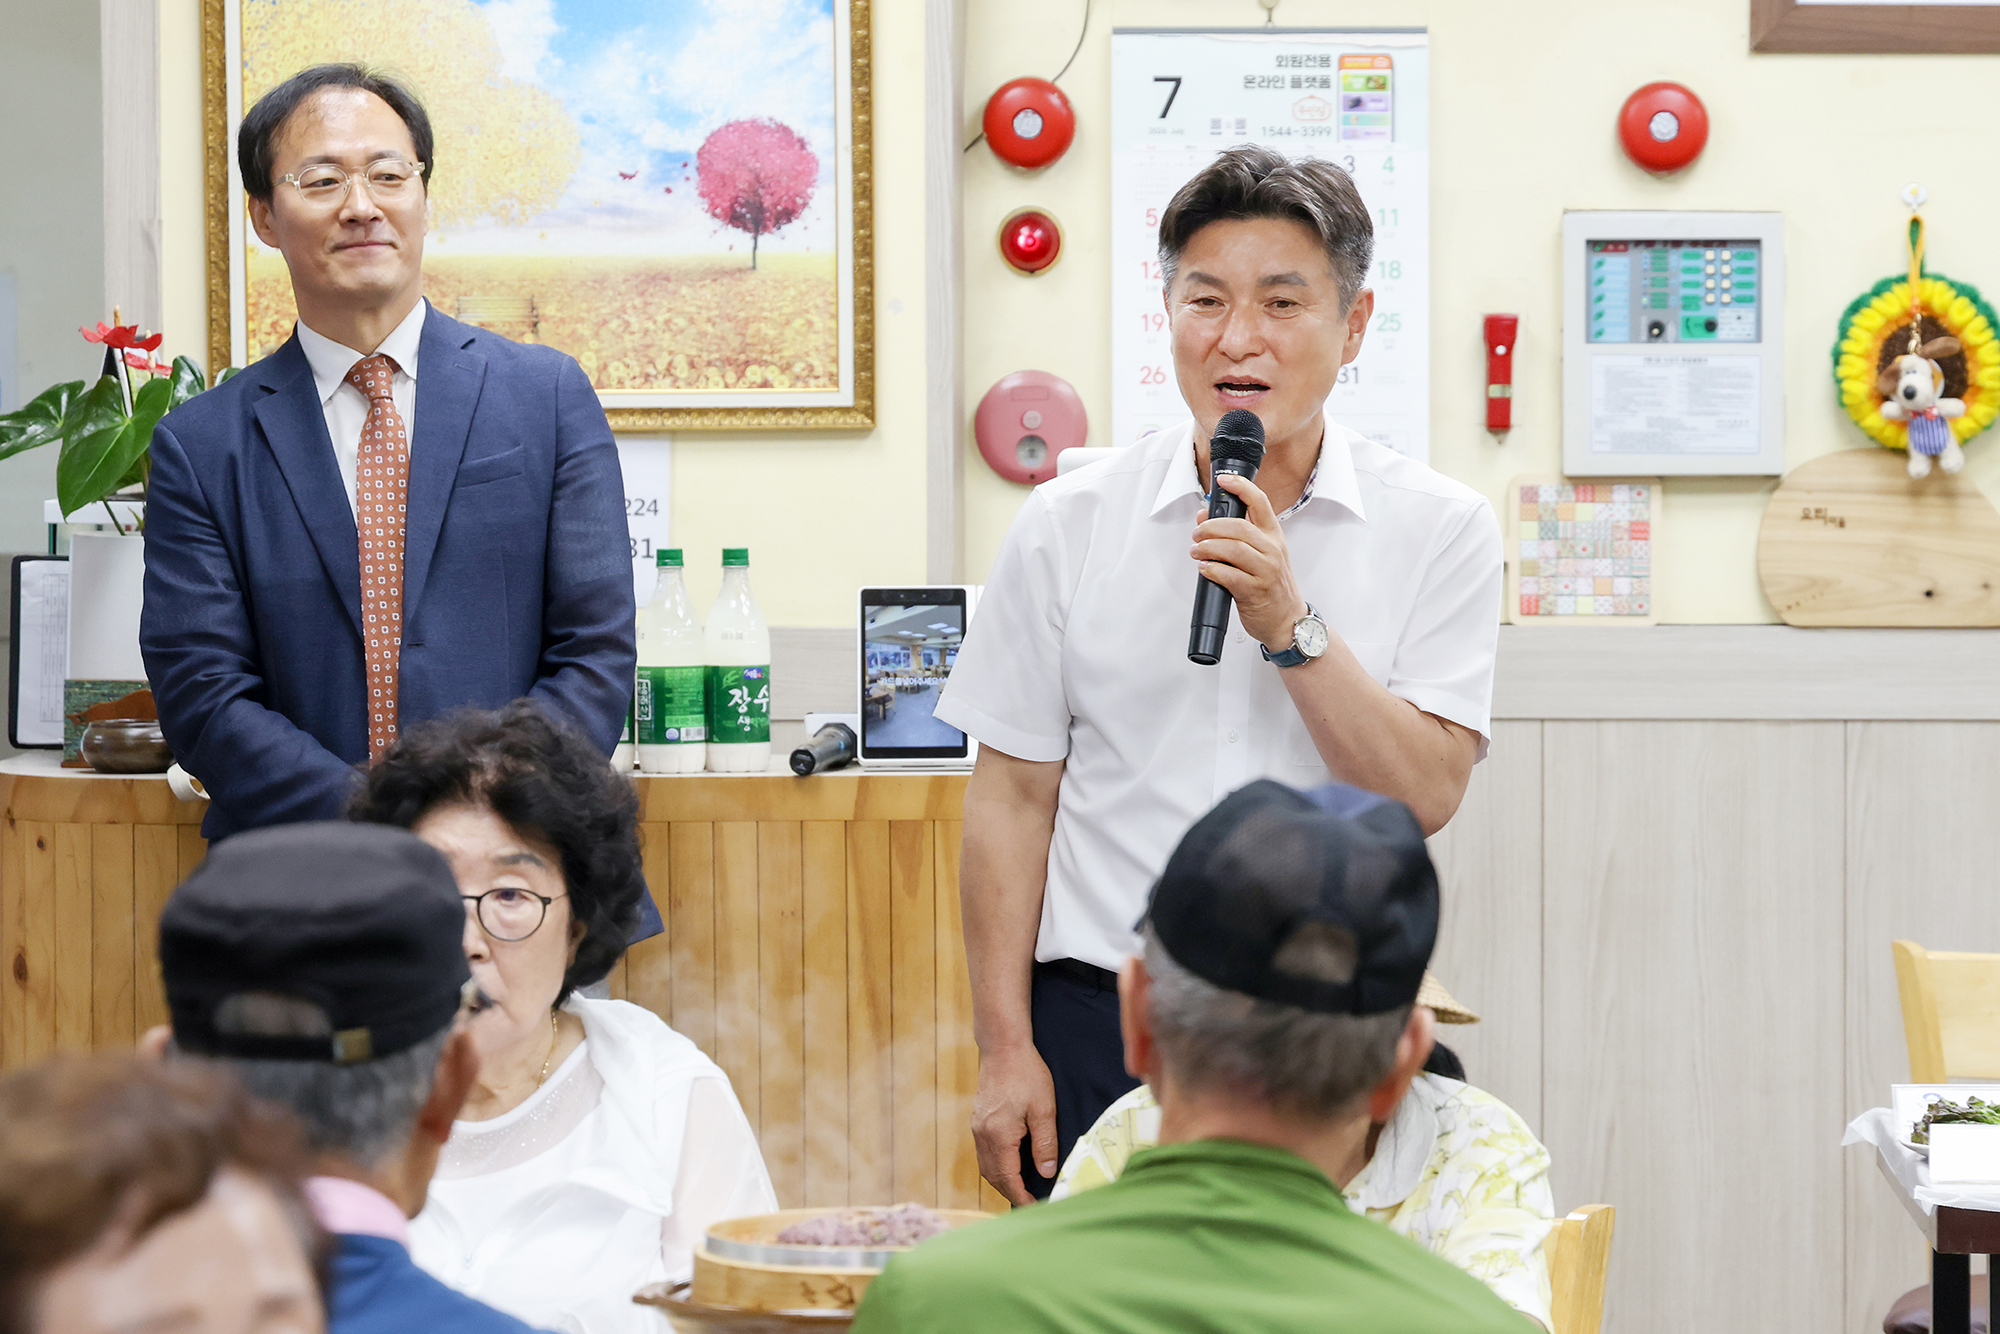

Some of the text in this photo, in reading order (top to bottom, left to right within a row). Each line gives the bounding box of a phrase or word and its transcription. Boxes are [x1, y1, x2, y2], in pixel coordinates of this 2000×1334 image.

[1244, 74, 1331, 89] 온라인 플랫폼
[1153, 75, 1182, 119] 7
[1261, 126, 1332, 138] 1544-3399
[1343, 154, 1396, 174] 3 4
[1145, 207, 1399, 226] 5 11
[1140, 260, 1402, 279] 12 18
[1140, 312, 1402, 332] 19 25
[1139, 365, 1166, 385] 26
[1337, 366, 1359, 384] 31
[727, 684, 769, 713] 장수
[737, 715, 751, 731] 생
